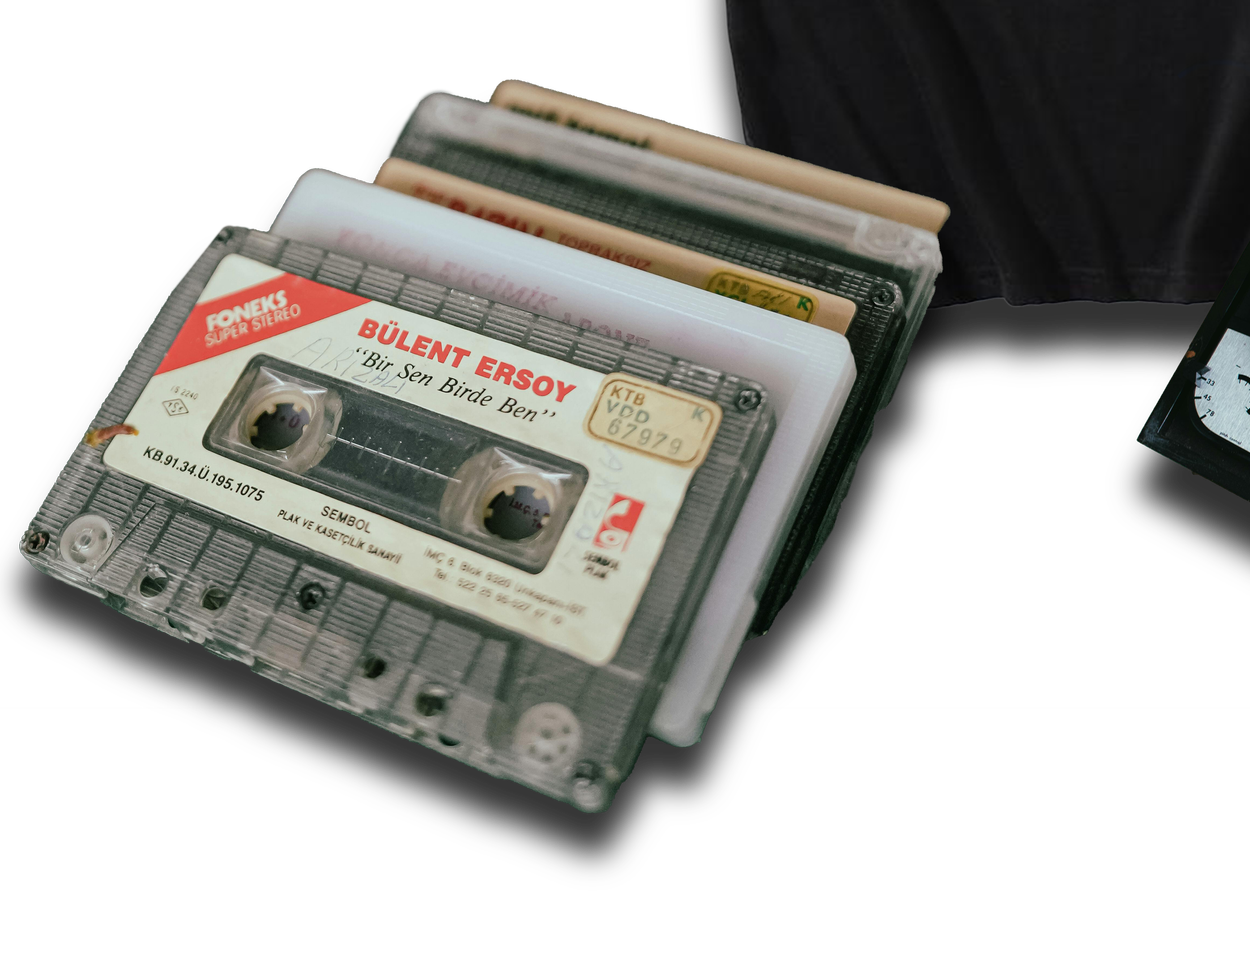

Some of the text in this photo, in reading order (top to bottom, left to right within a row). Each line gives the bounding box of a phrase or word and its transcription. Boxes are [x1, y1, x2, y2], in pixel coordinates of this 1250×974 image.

[205, 289, 288, 332] FONEKS
[204, 303, 301, 348] SUPER STEREO
[357, 318, 577, 403] BÜLENT ERSOY
[396, 363, 433, 387] Sen
[438, 376, 493, 408] Birde
[610, 384, 646, 407] KTB
[1206, 378, 1215, 386] 33
[606, 399, 650, 424] VDD
[1203, 393, 1212, 401] 45
[691, 406, 708, 423] K
[1205, 408, 1214, 416] 78
[606, 417, 684, 456] 67979
[143, 445, 265, 502] KB.91.34.Ü.195.1075
[277, 509, 301, 526] PLAK
[302, 518, 313, 531] VE
[314, 522, 364, 550] KASETÇİLİK
[320, 505, 371, 534] SEMBOL
[459, 560, 483, 577] Blok
